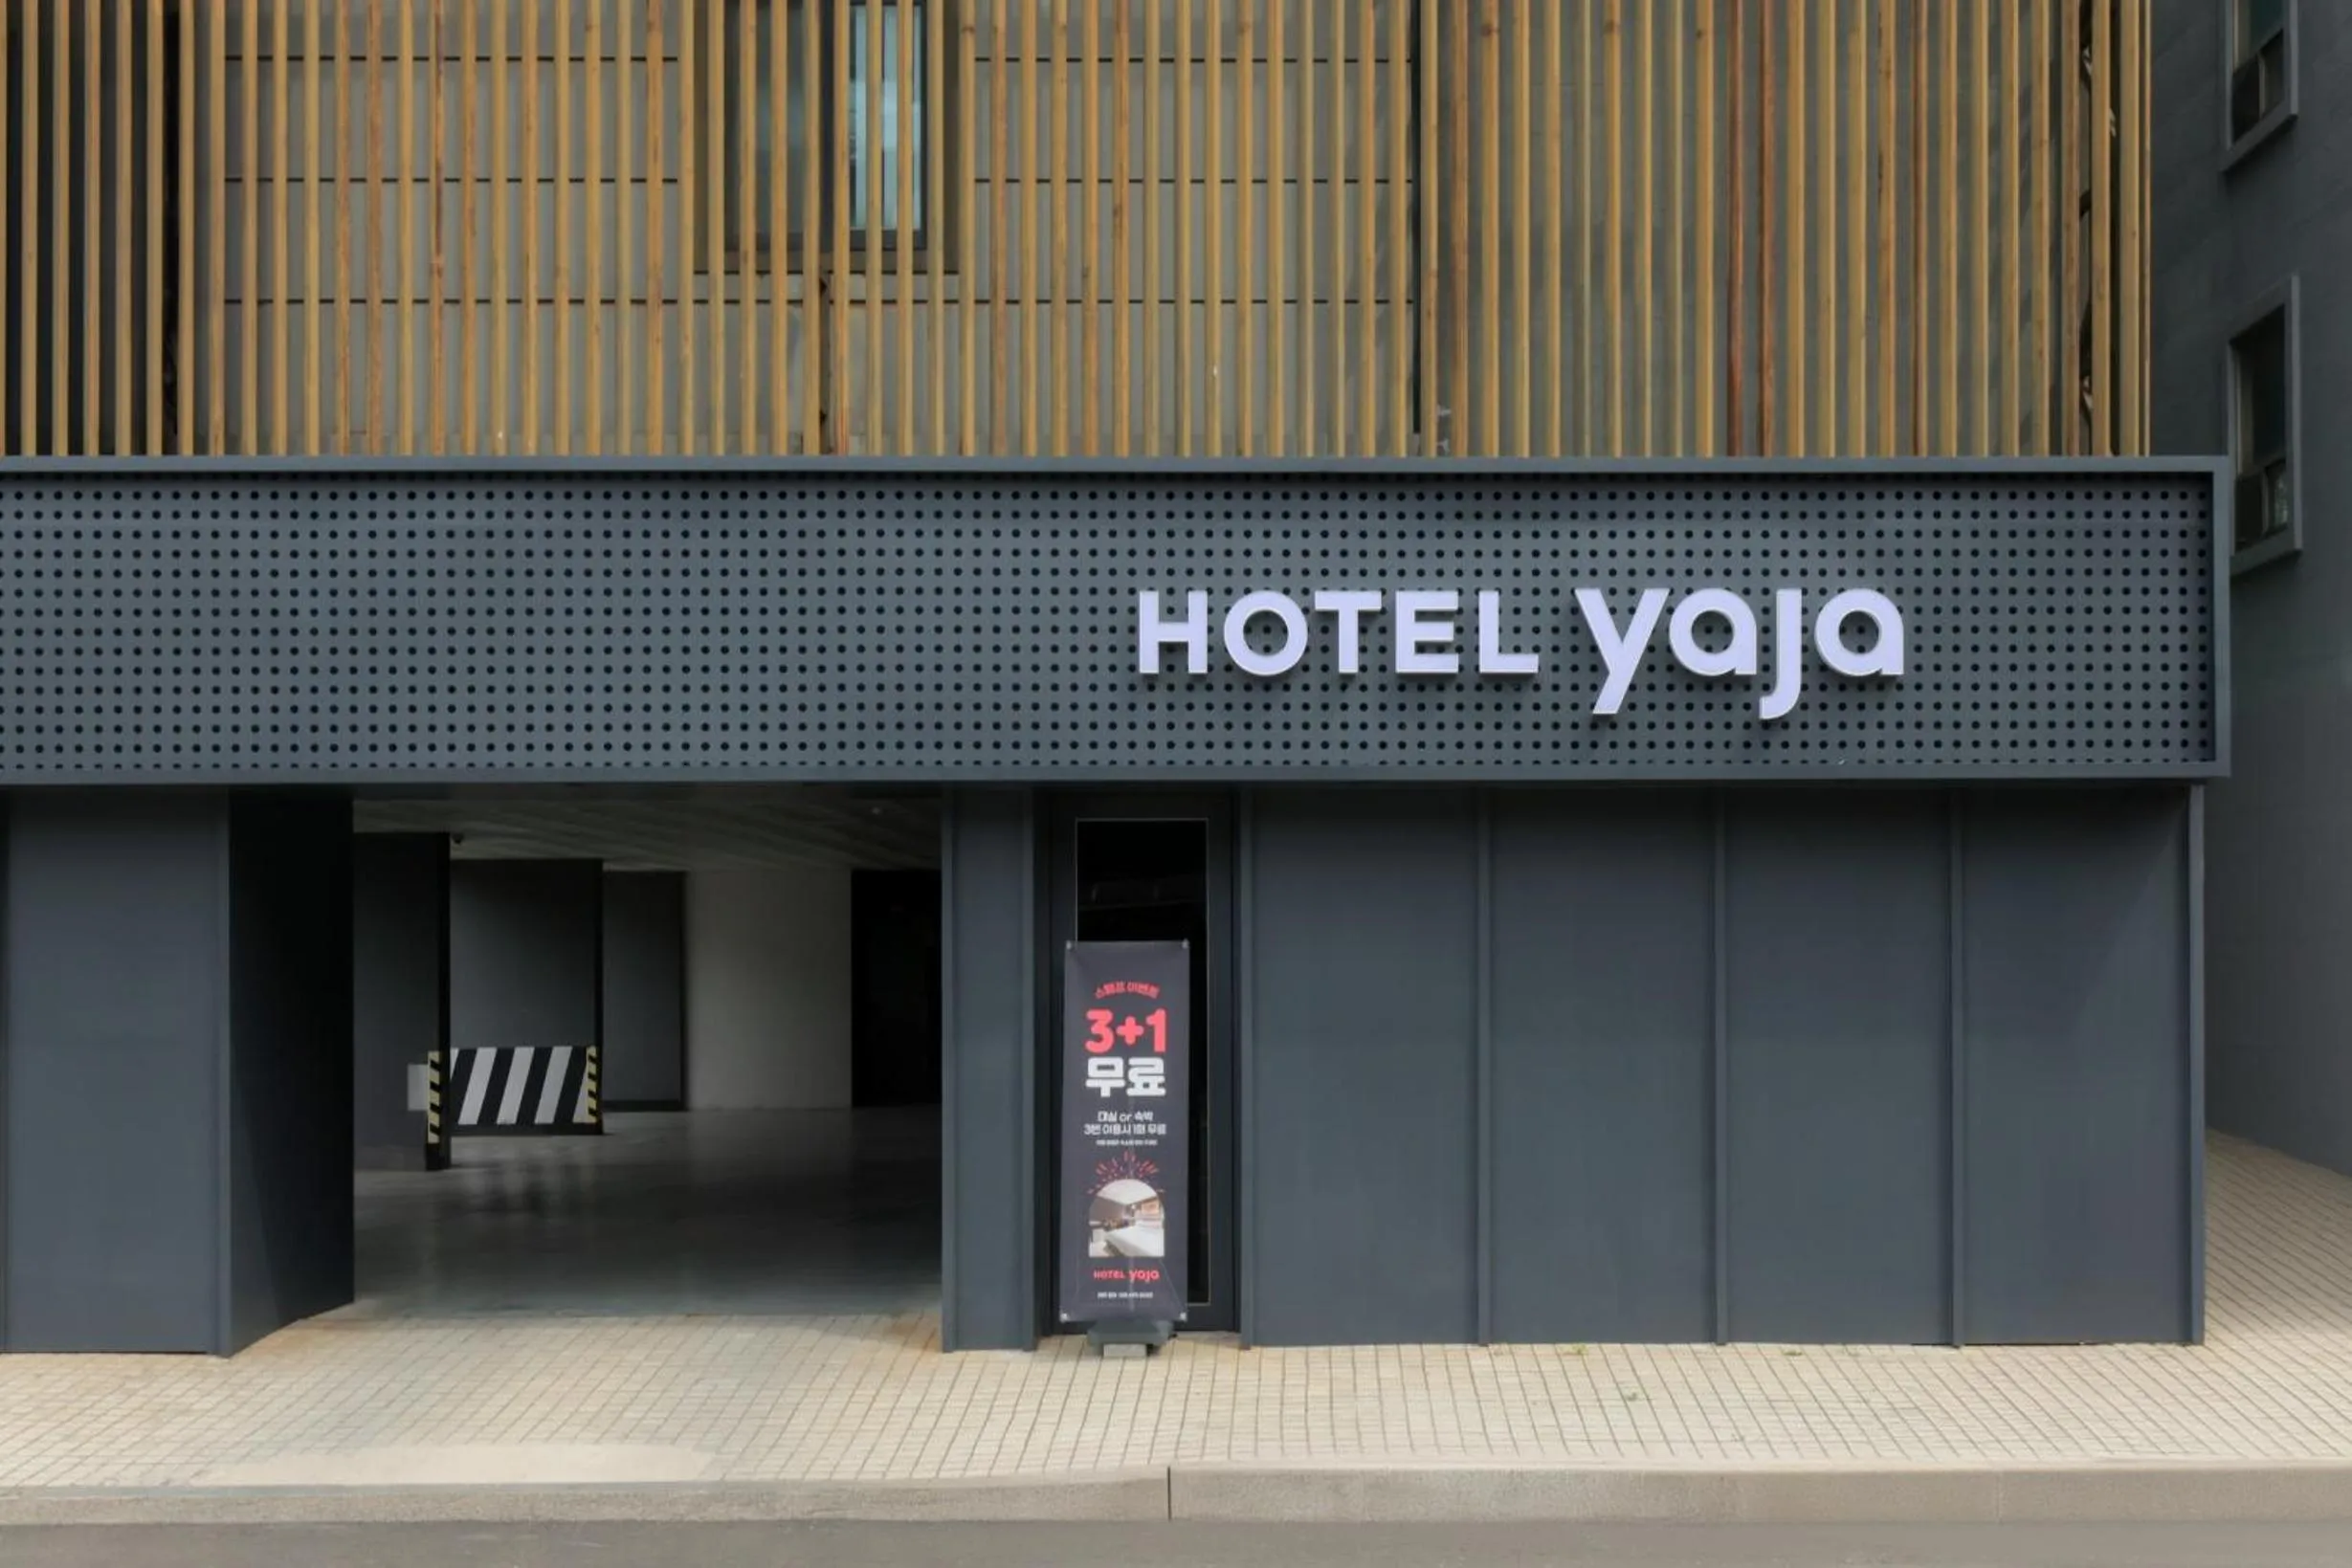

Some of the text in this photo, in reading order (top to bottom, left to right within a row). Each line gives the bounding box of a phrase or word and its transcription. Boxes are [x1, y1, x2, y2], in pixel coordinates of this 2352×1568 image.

[1139, 588, 1904, 721] HOTEL yaja
[1084, 1007, 1166, 1053] 3+1
[1085, 1056, 1166, 1097] 무료
[1119, 1114, 1132, 1122] or
[1094, 1269, 1124, 1279] HOTEL
